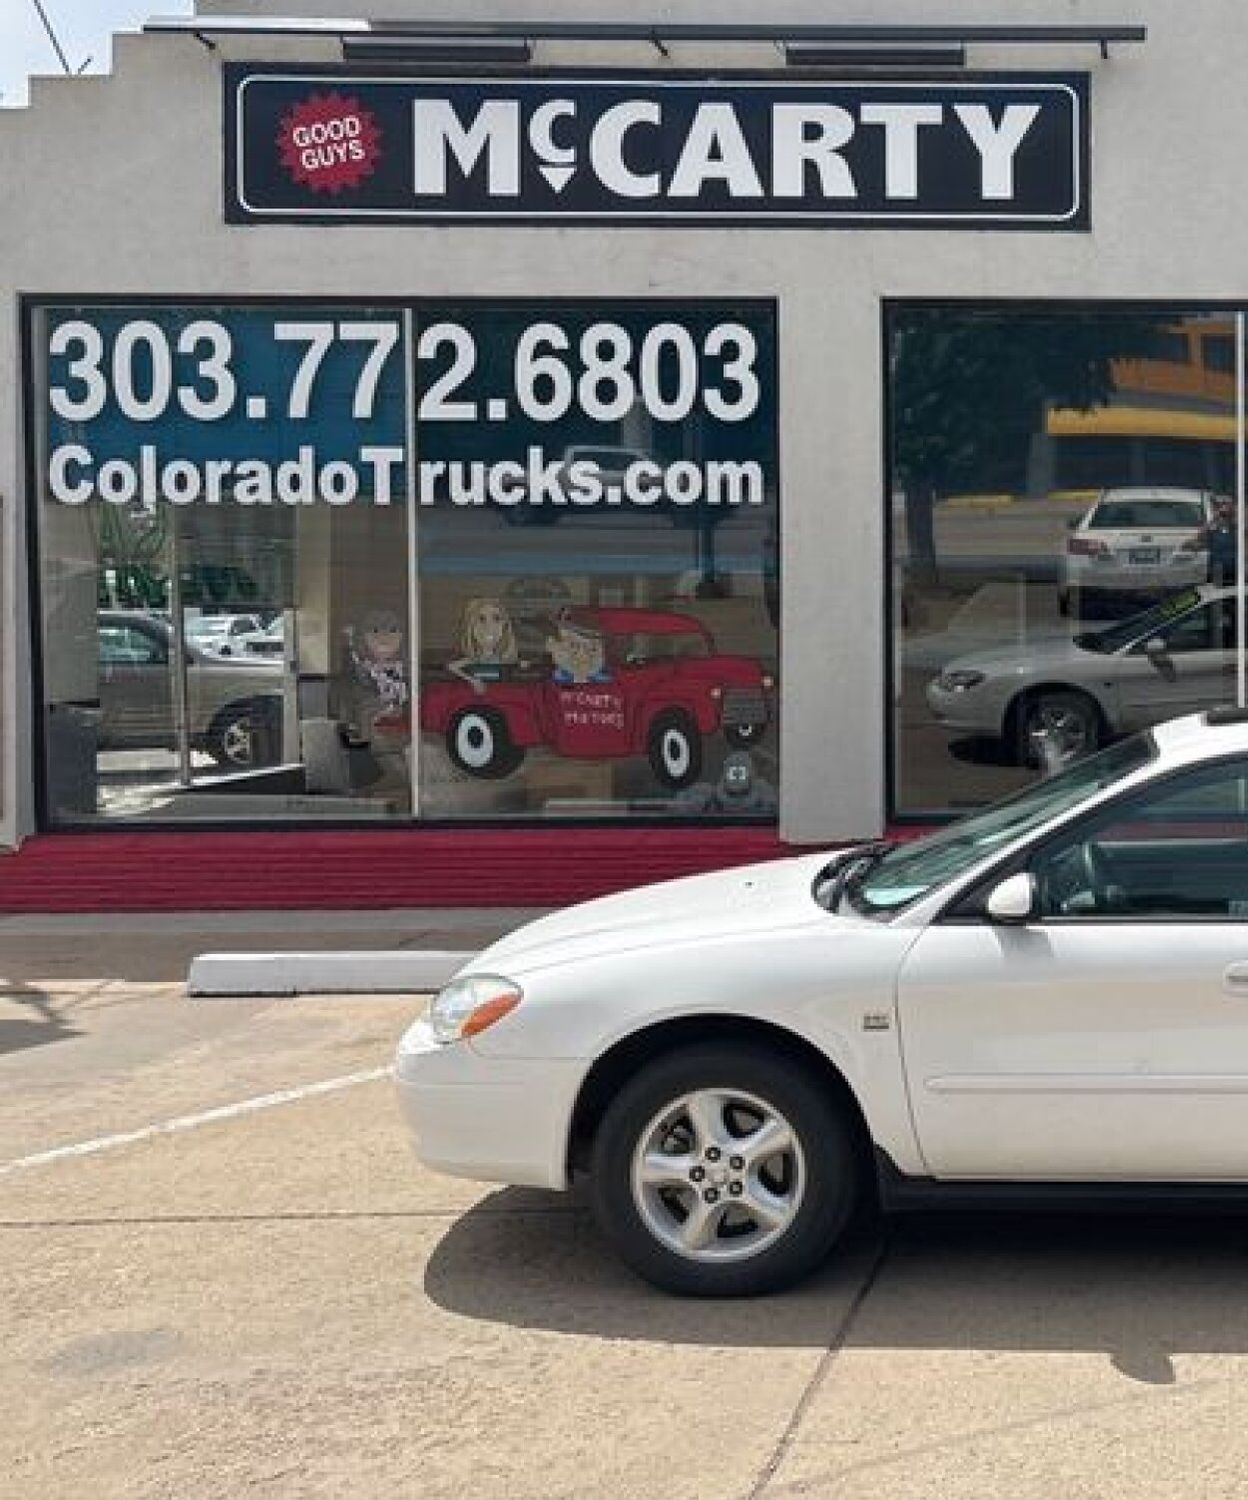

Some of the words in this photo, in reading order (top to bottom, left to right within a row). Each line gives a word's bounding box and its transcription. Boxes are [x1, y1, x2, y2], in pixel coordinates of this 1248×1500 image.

[293, 116, 360, 147] GOOD
[302, 139, 366, 169] GUYS
[48, 320, 760, 423] 303.772.6803
[48, 445, 765, 508] ColoradoTrucks.com
